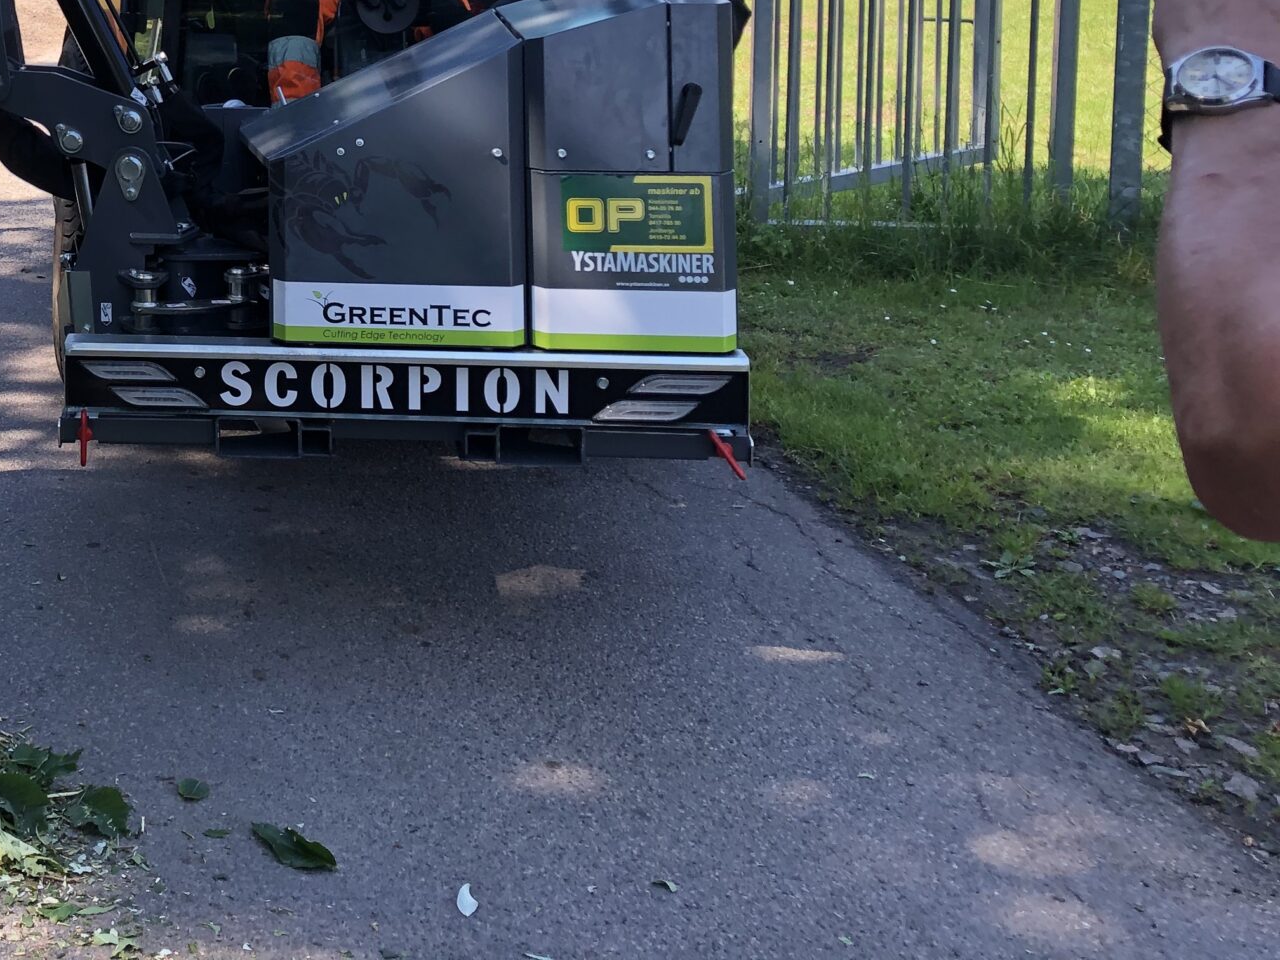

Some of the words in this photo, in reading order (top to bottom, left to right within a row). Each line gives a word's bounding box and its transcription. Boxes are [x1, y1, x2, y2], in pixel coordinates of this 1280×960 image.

[648, 187, 687, 195] maskiner
[566, 197, 645, 233] OP
[323, 330, 358, 341] Cutting
[361, 331, 385, 341] Edge
[389, 331, 445, 343] Technology
[220, 361, 570, 414] SCORPION
